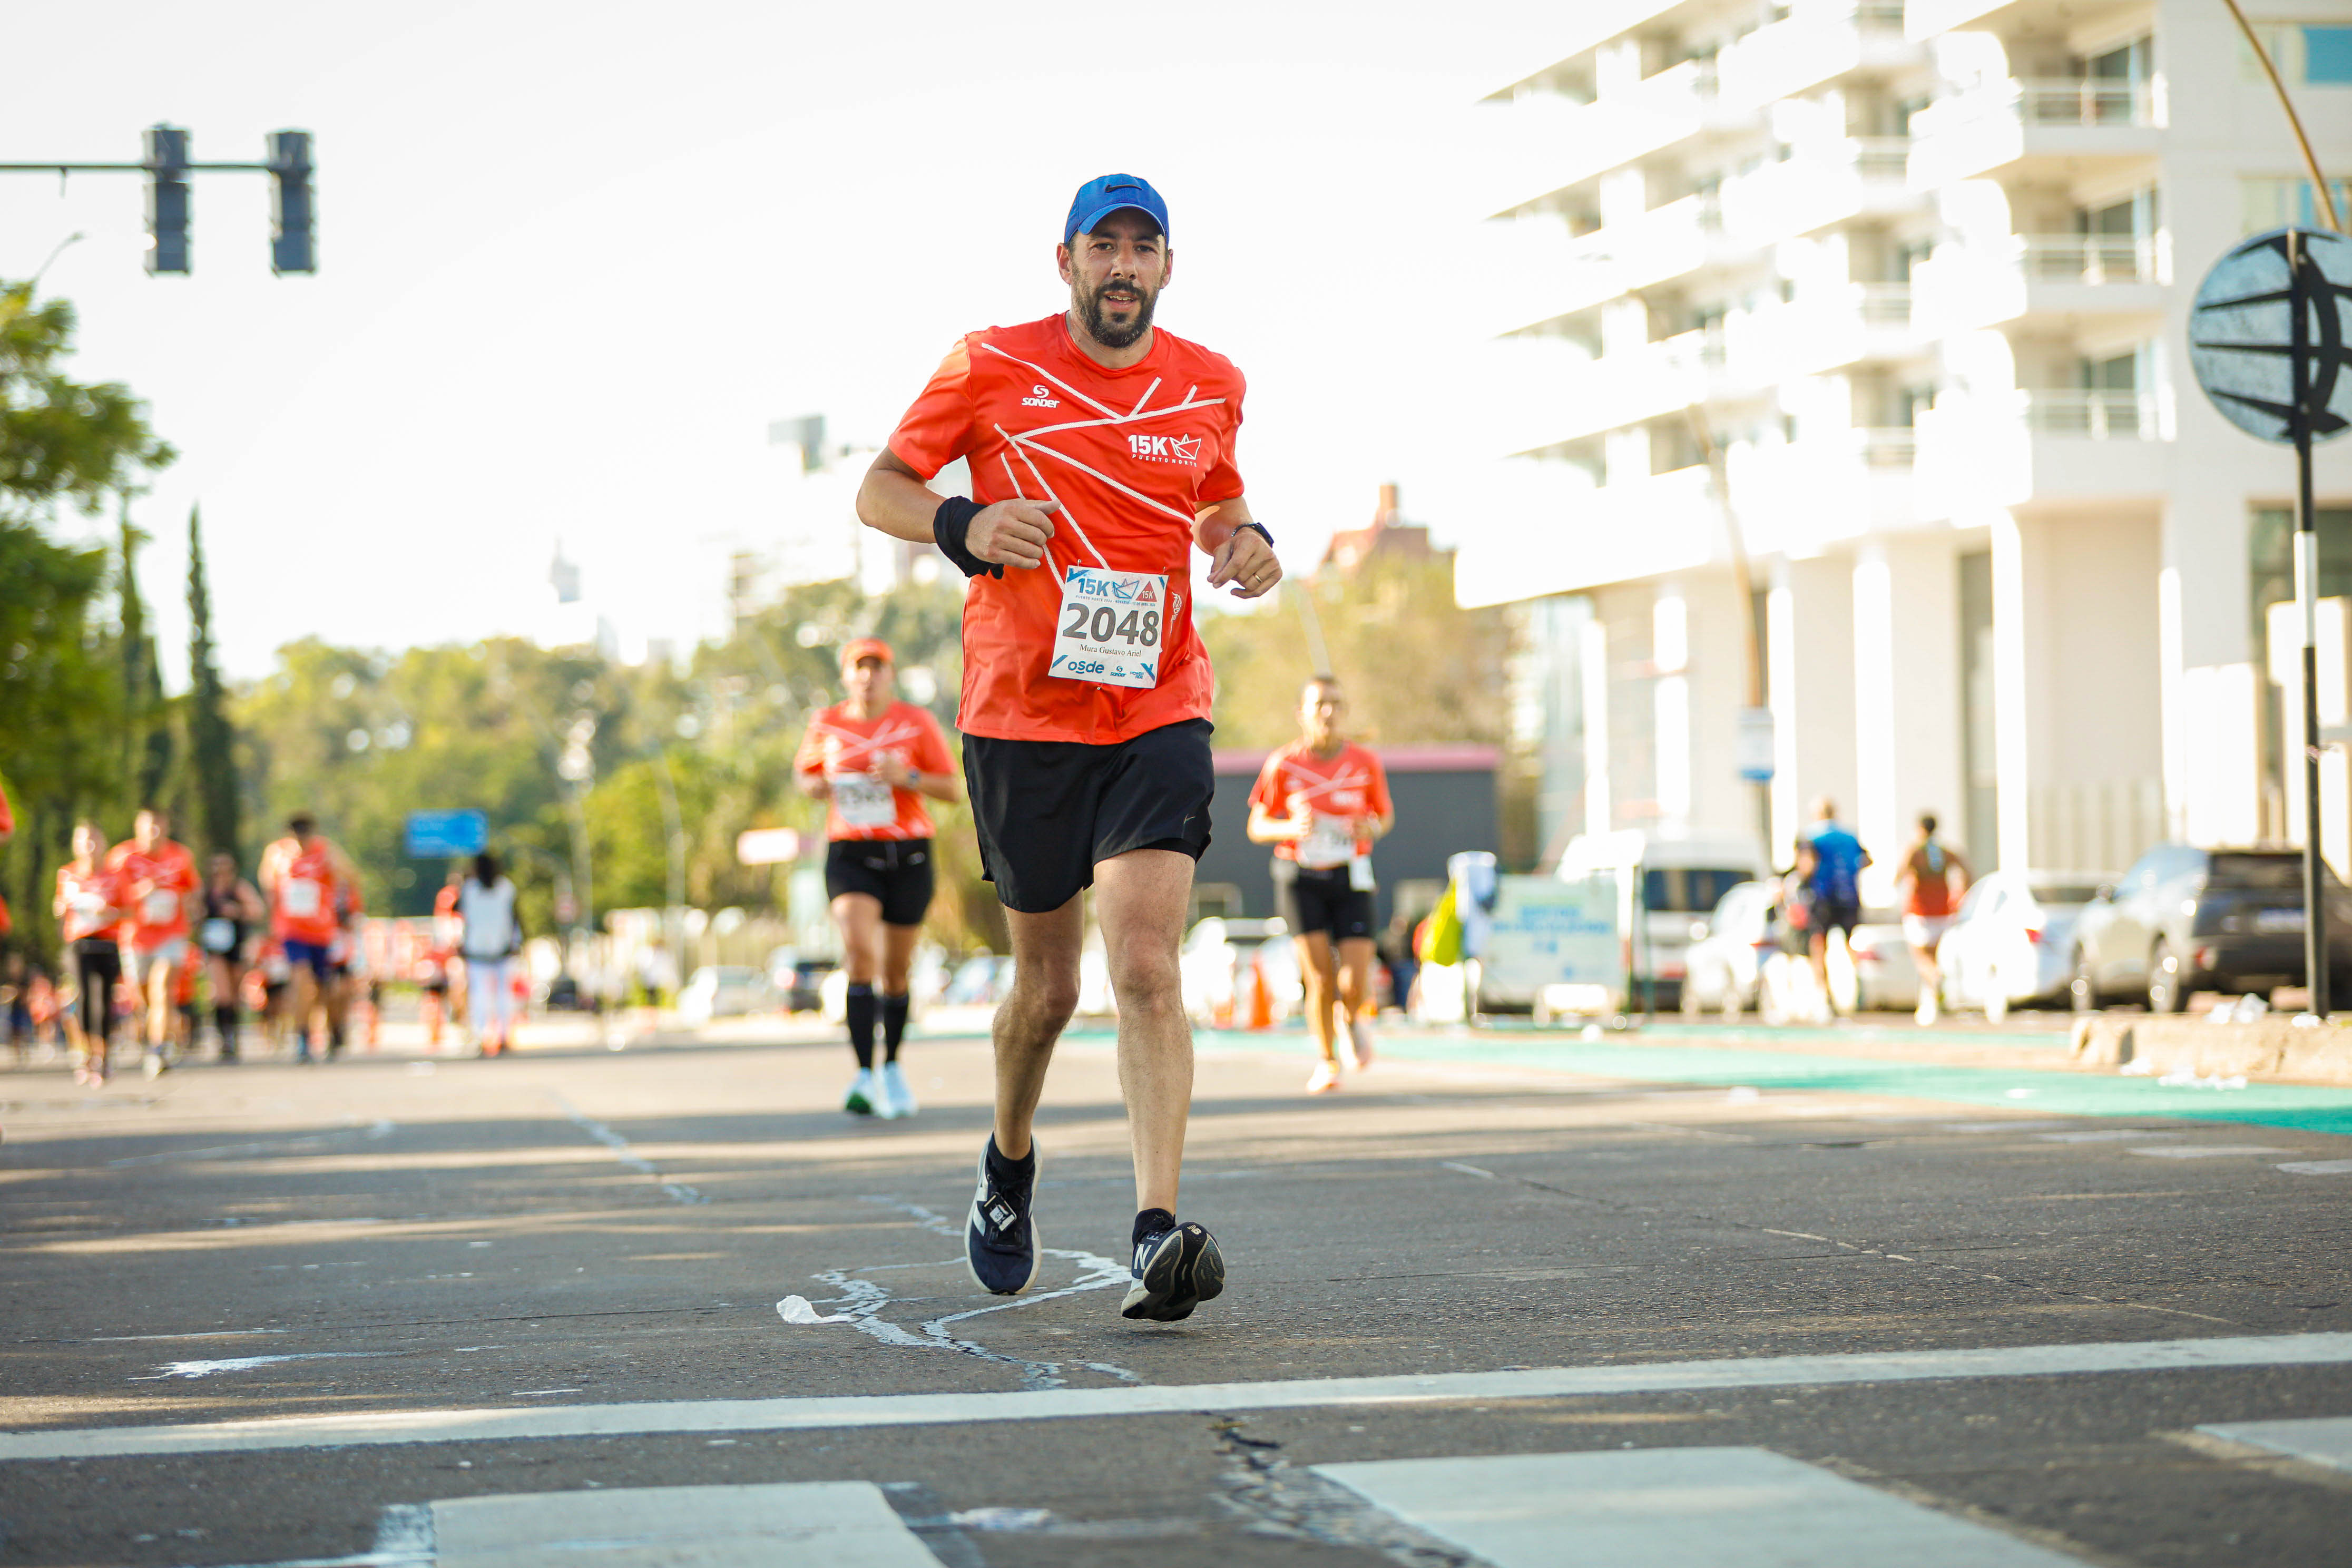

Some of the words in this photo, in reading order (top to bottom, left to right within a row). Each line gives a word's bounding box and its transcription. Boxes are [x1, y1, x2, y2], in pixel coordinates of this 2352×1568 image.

[1128, 434, 1168, 456] 15K
[1132, 454, 1168, 463] PUERTO
[1172, 458, 1197, 467] NORTE
[1078, 578, 1111, 596] 15K
[1142, 590, 1153, 599] 15K
[1062, 603, 1159, 646] 2048
[1080, 644, 1097, 653] Mura
[1099, 646, 1125, 656] Gustavo
[1067, 660, 1105, 674] osde
